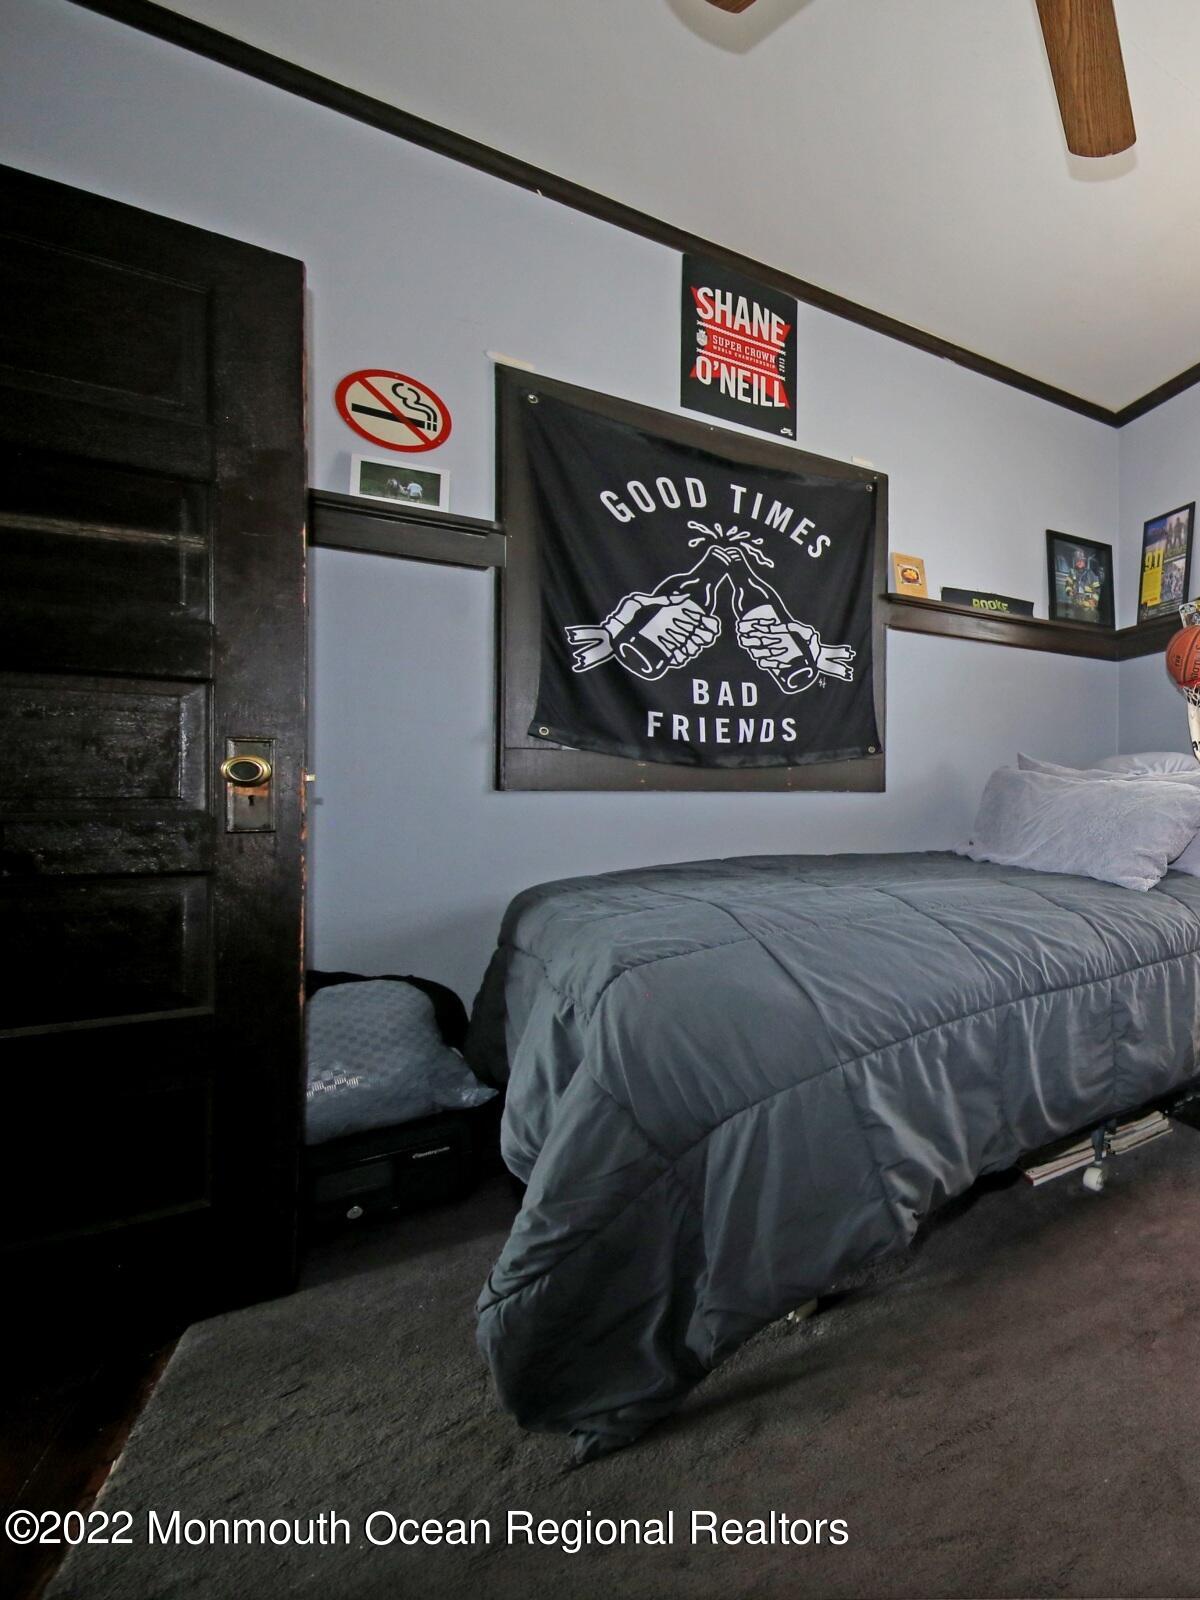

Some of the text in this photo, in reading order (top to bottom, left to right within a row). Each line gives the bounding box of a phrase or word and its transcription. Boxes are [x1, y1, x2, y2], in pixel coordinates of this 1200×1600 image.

[696, 287, 785, 347] SHANE
[712, 334, 776, 364] SUPER CROWN
[695, 356, 785, 408] O'NEILL
[600, 477, 831, 558] GOOD TIMES
[692, 678, 759, 707] BAD
[646, 711, 797, 744] FRIENDS
